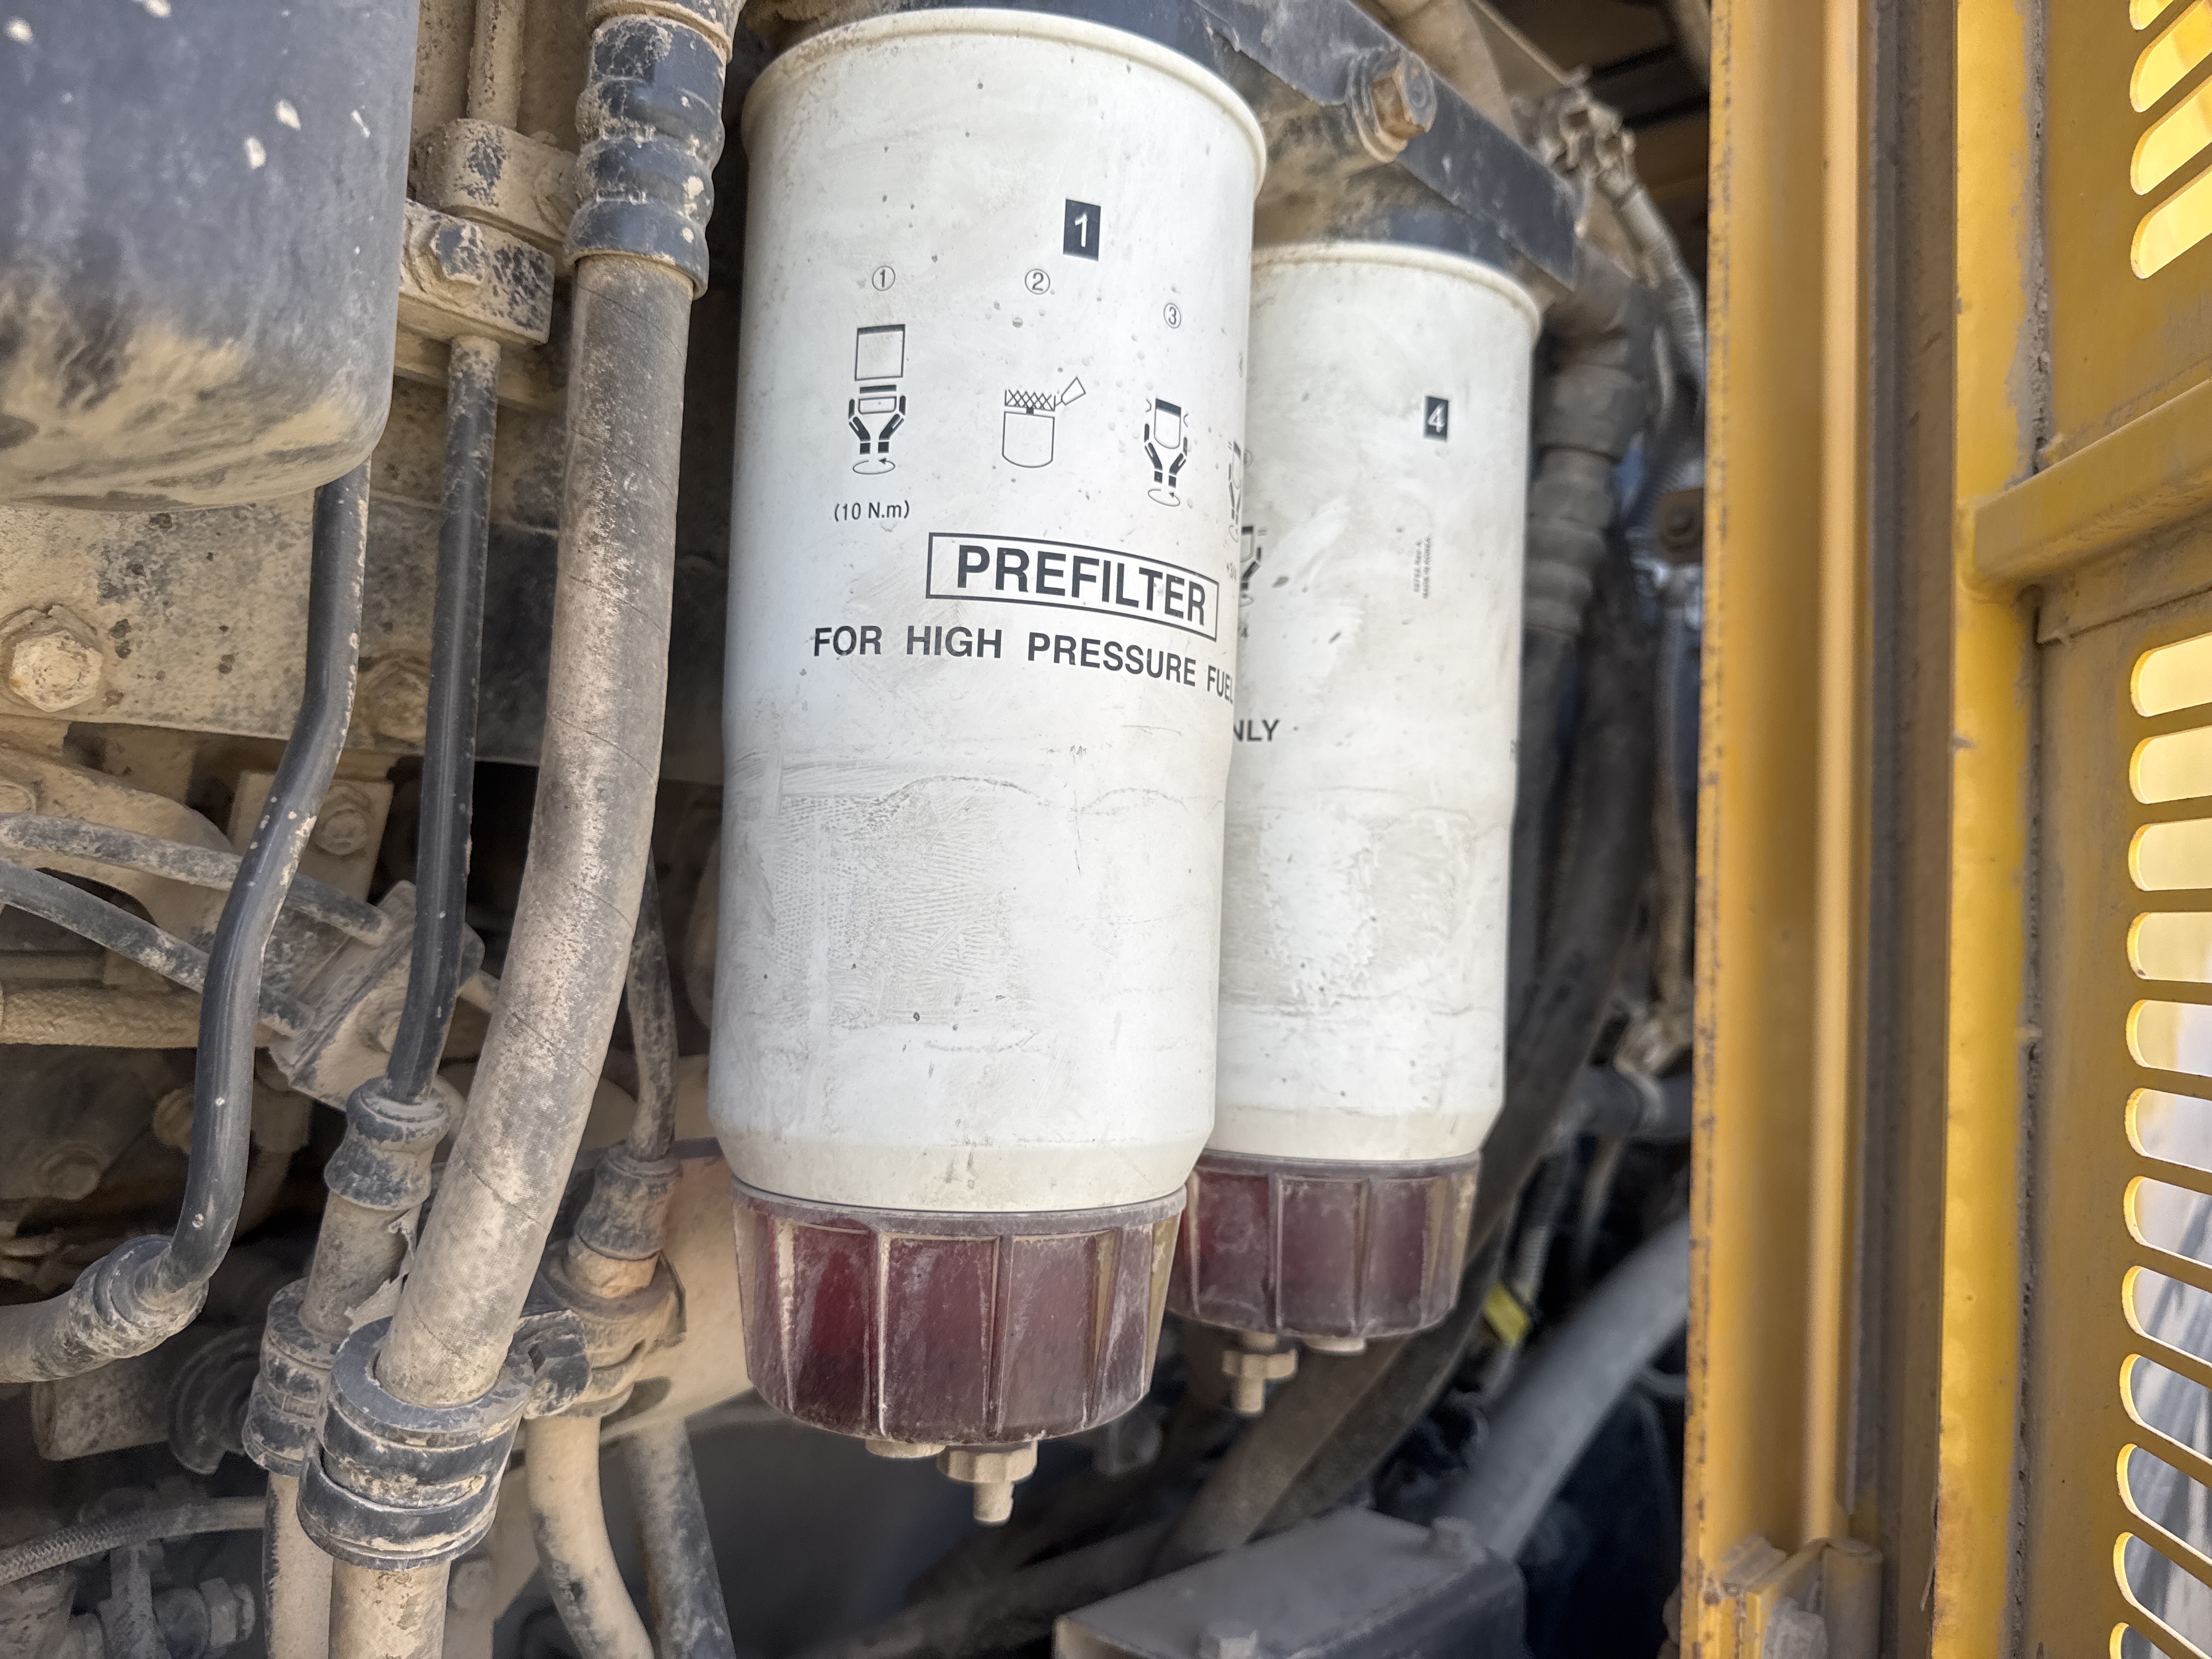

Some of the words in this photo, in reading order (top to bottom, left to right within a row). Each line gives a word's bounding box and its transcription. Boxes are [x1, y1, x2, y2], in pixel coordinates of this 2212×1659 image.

[1427, 402, 1446, 433] 4
[834, 502, 861, 522] (10
[868, 500, 910, 519] N.m)
[957, 545, 1205, 625] PREFILTER
[814, 625, 882, 657] FOR
[906, 625, 1002, 659] HIGH
[1028, 632, 1196, 687] PRESSURE
[1207, 665, 1233, 705] FUEL
[1233, 719, 1279, 742] NLY
